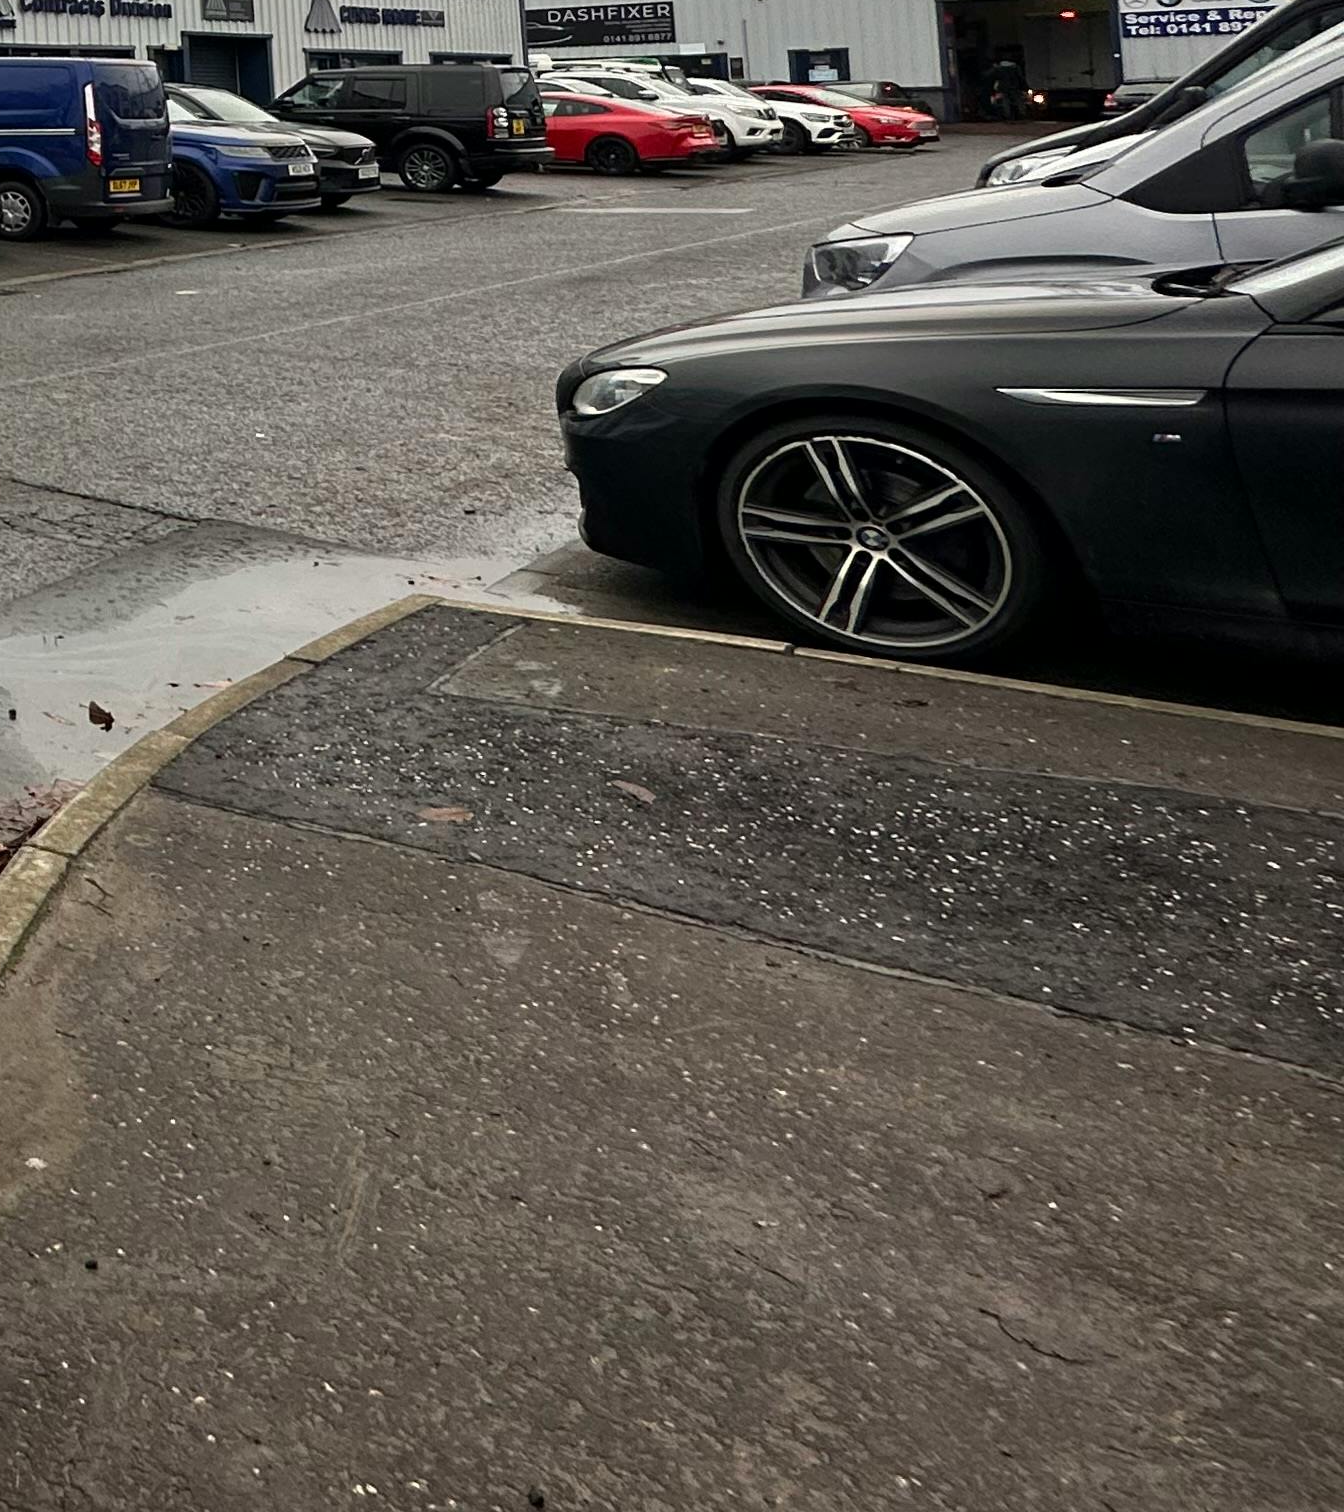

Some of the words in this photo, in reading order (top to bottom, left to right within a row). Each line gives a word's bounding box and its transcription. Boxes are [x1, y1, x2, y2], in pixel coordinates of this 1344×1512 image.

[547, 3, 671, 23] DASHFIXER
[1124, 12, 1200, 25] Service
[1206, 10, 1223, 21] &
[1126, 25, 1161, 36] Tel:
[1166, 22, 1212, 34] 0141
[603, 35, 626, 43] 0141
